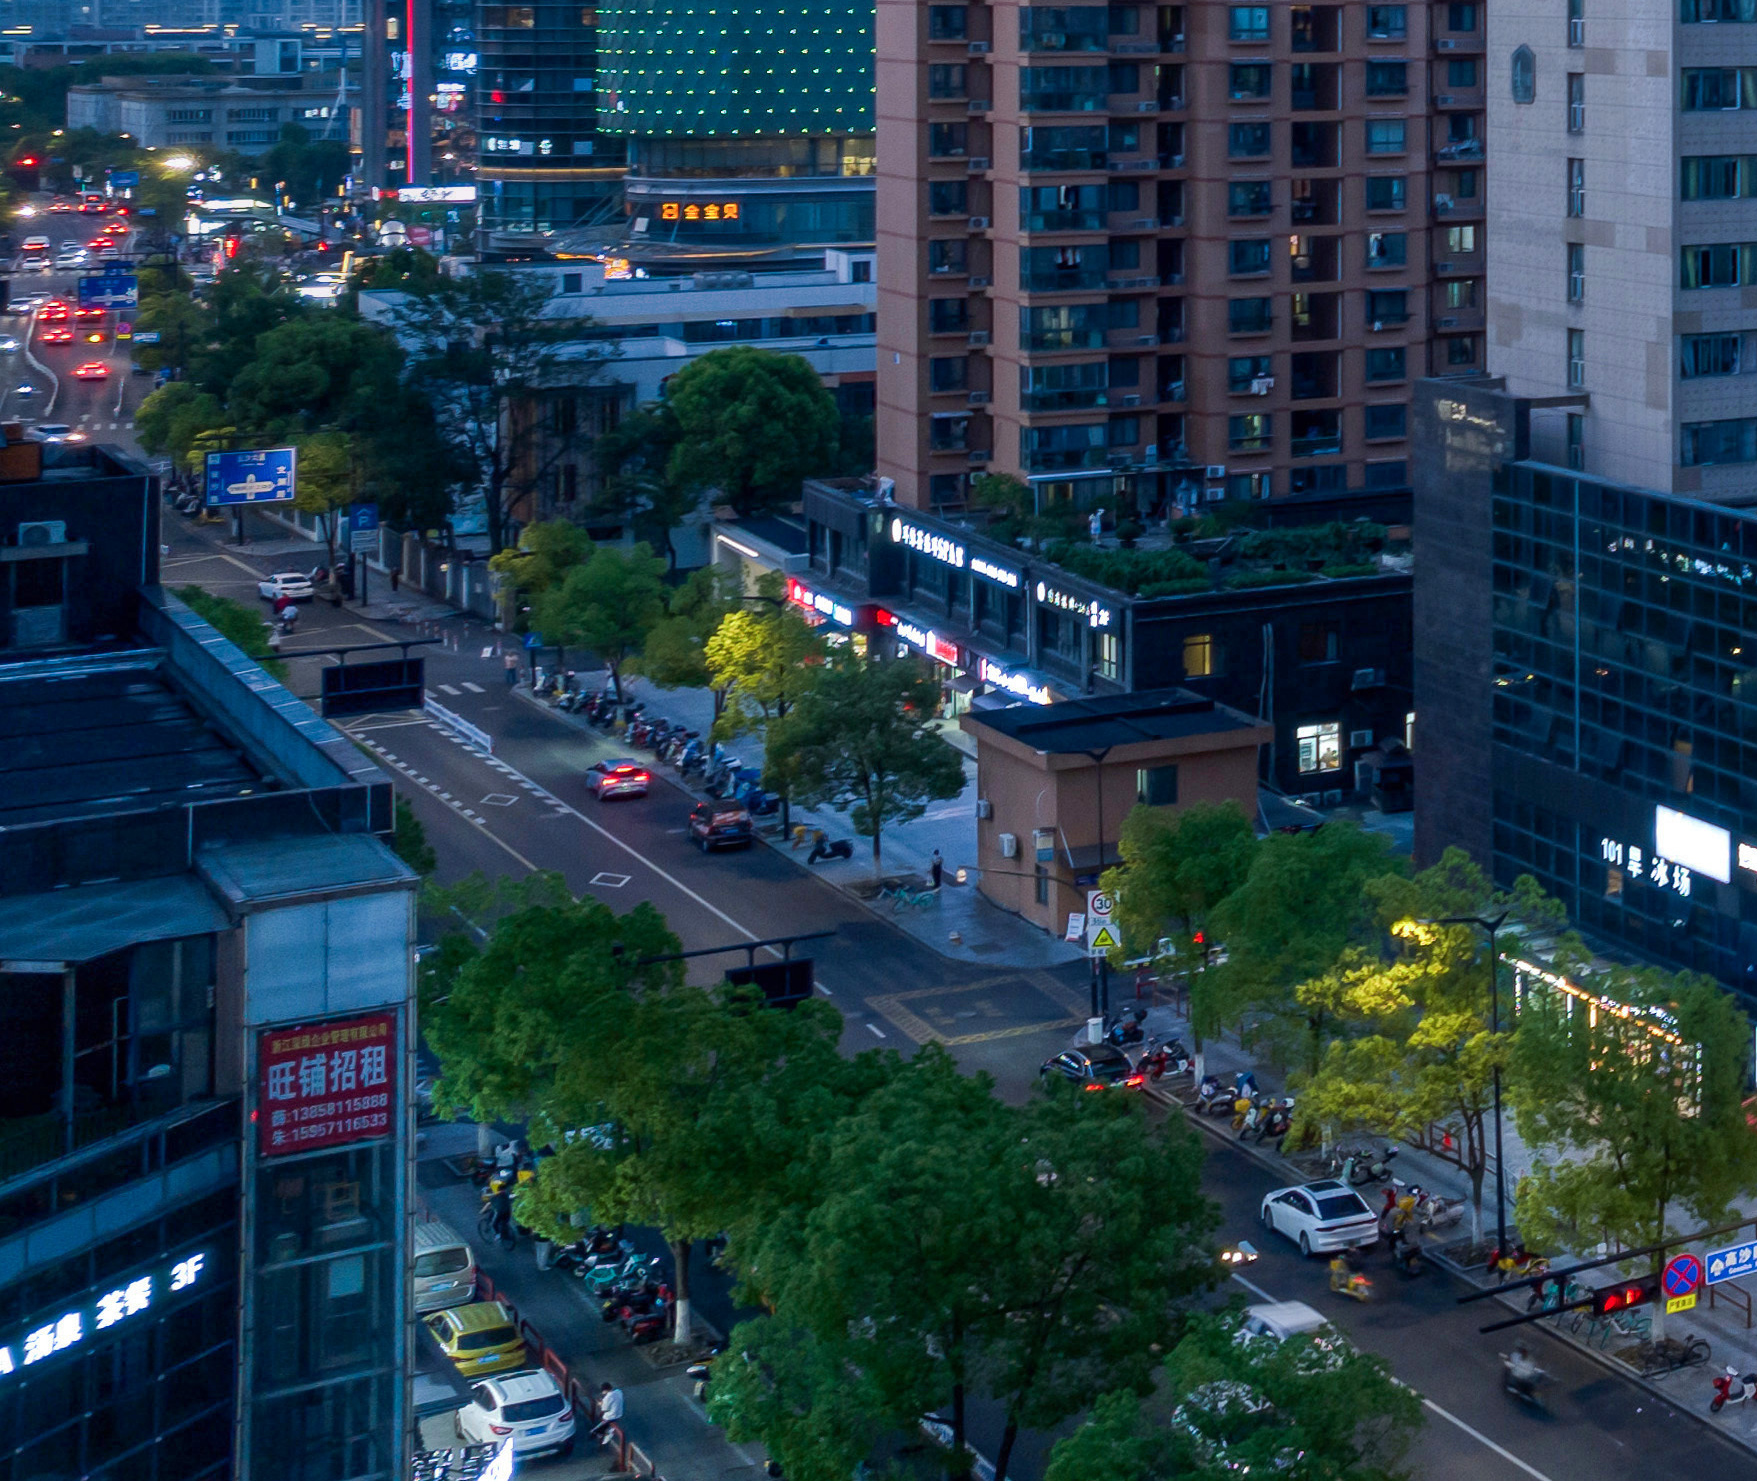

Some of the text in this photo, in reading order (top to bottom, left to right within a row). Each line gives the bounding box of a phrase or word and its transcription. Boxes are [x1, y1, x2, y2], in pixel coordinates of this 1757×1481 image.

[1601, 838, 1623, 866] 101
[1627, 845, 1691, 897] 旱冰场
[1096, 898, 1112, 910] 30
[268, 1045, 387, 1100] 旺铺招租
[169, 1252, 205, 1292] 3F
